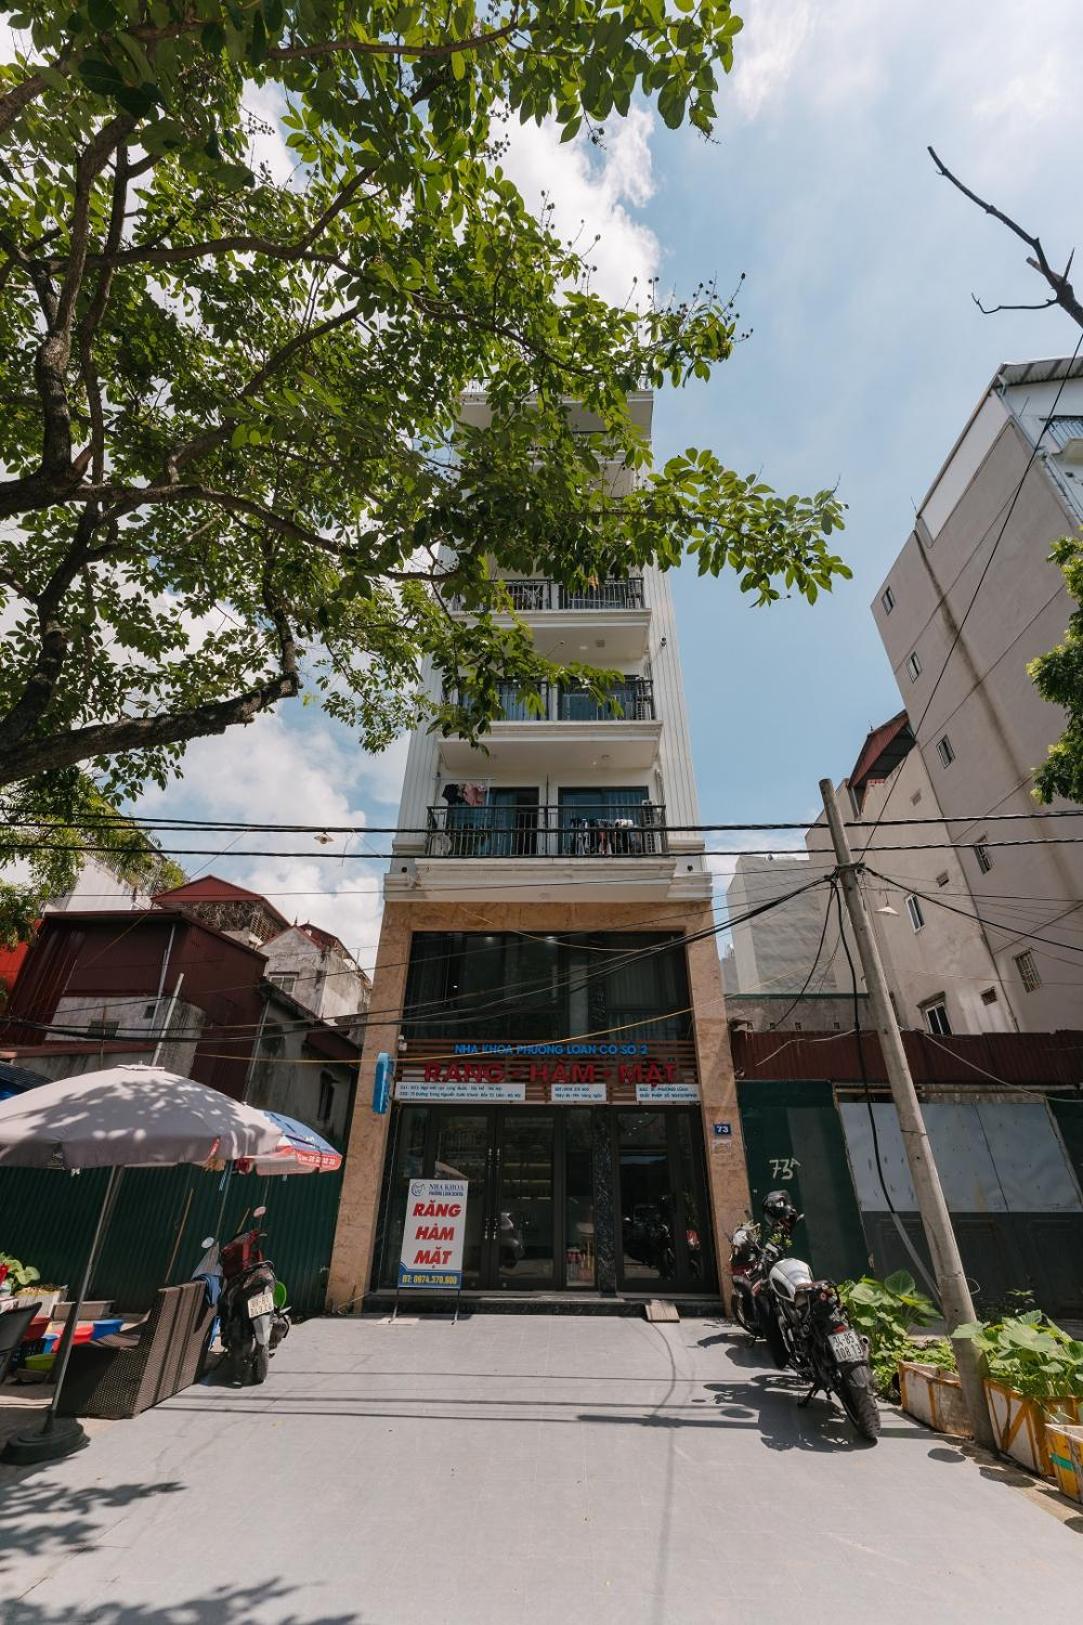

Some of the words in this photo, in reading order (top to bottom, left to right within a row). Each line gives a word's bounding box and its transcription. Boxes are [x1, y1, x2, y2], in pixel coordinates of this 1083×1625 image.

[454, 1043, 478, 1054] NHA
[481, 1043, 513, 1055] KHOA
[566, 1045, 596, 1055] LOAN
[716, 1125, 729, 1134] 73
[412, 1199, 462, 1218] RĂNG
[413, 1246, 452, 1269] MẶT
